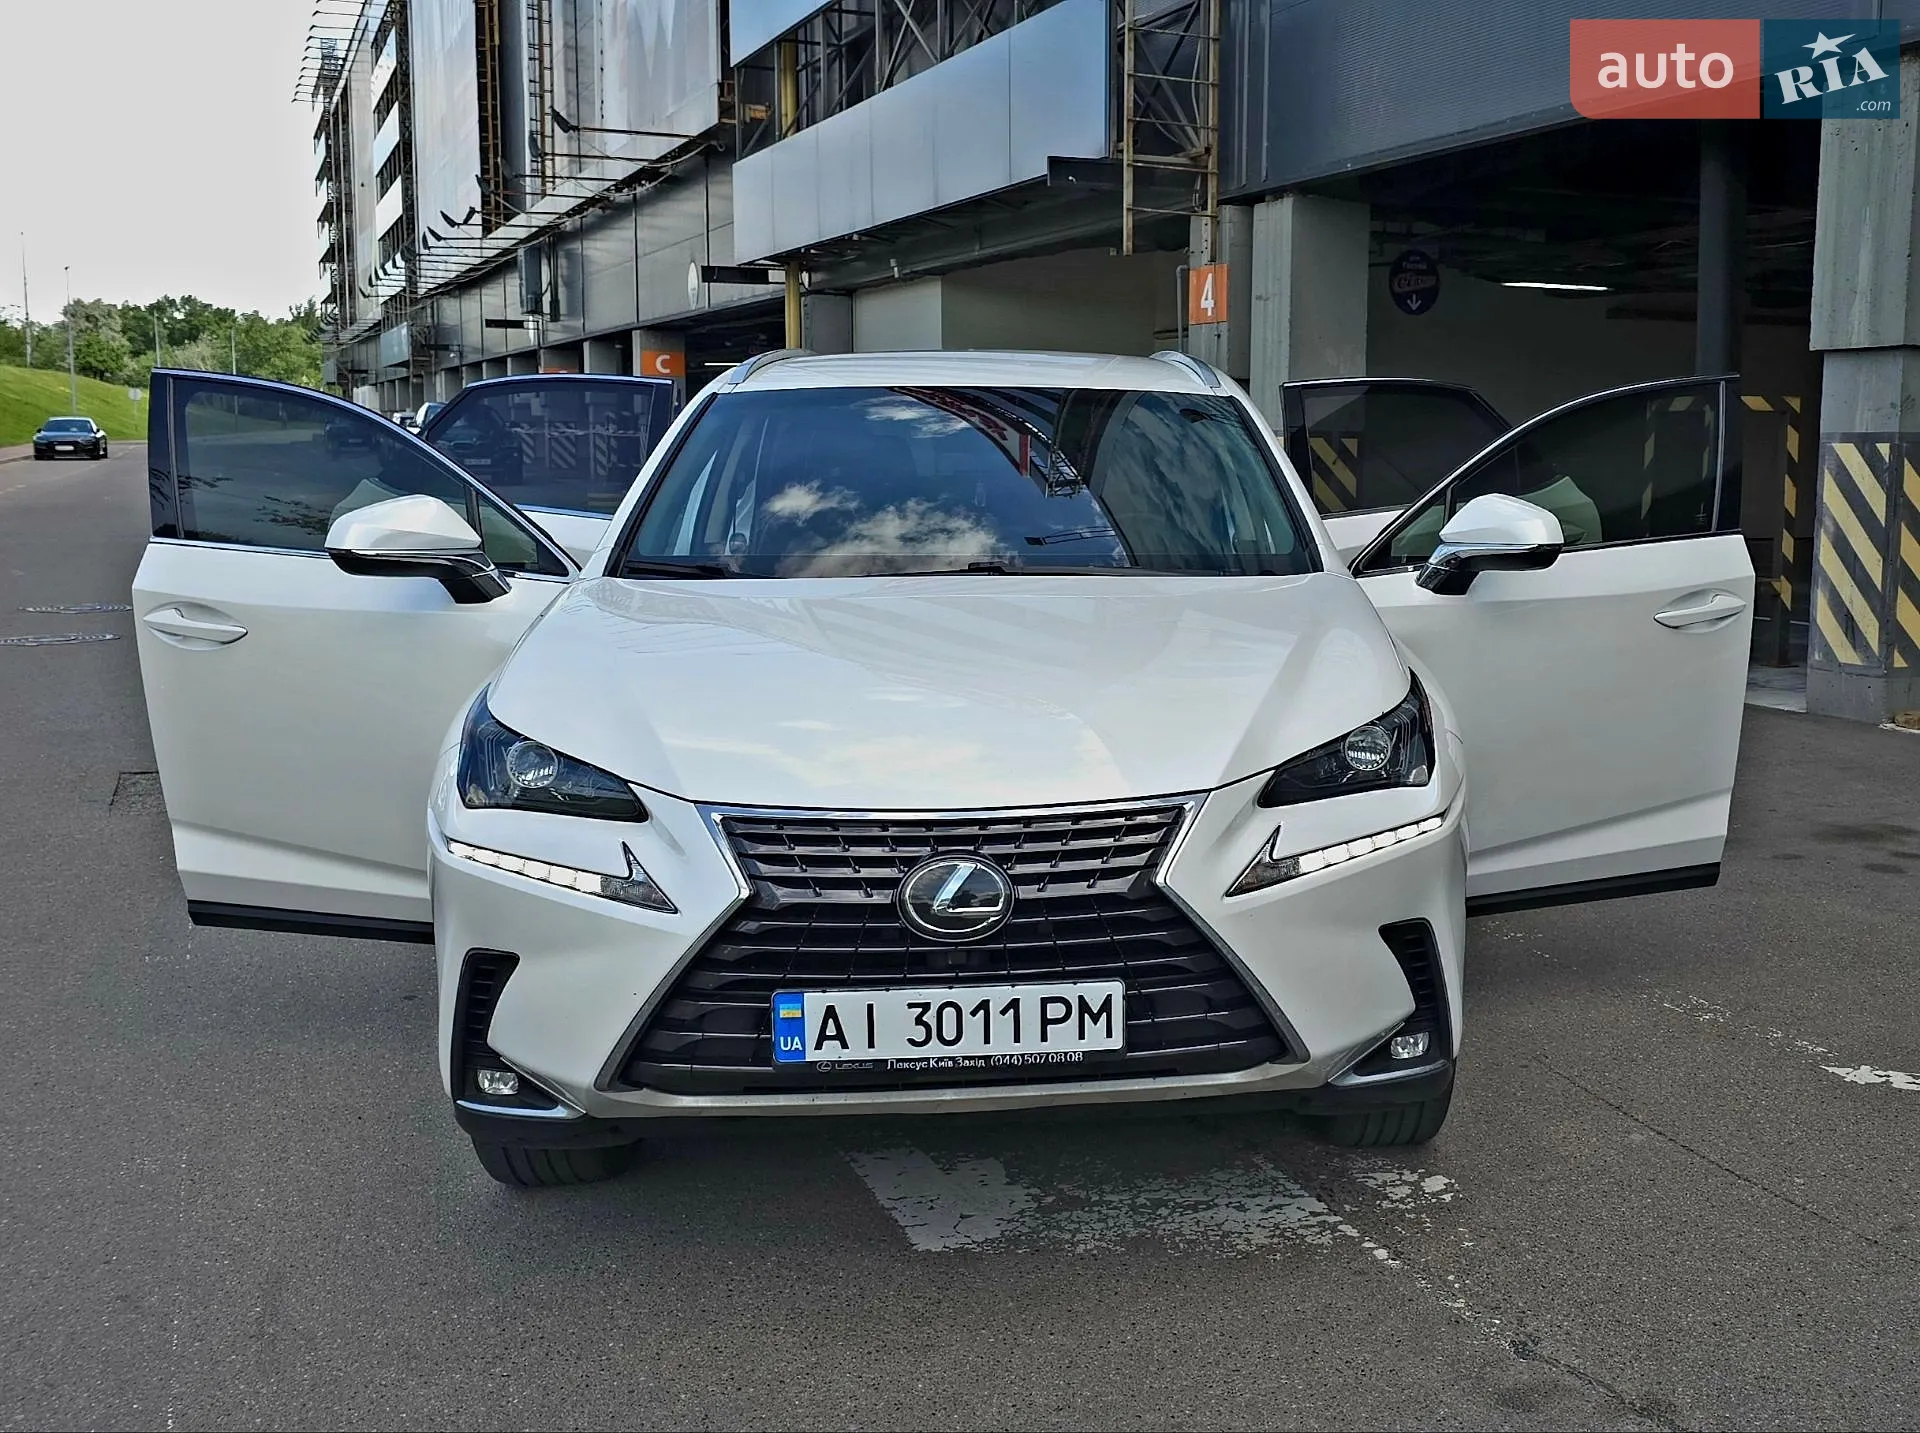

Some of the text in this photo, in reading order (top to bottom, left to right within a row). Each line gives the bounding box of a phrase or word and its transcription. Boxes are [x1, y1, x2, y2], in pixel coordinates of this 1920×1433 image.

[1200, 272, 1214, 316] 4
[655, 354, 671, 374] C
[906, 996, 1021, 1048] 3011
[1039, 993, 1113, 1043] PM
[780, 1036, 802, 1051] UA
[835, 1062, 873, 1070] LEXUS
[1024, 1053, 1046, 1065] 507
